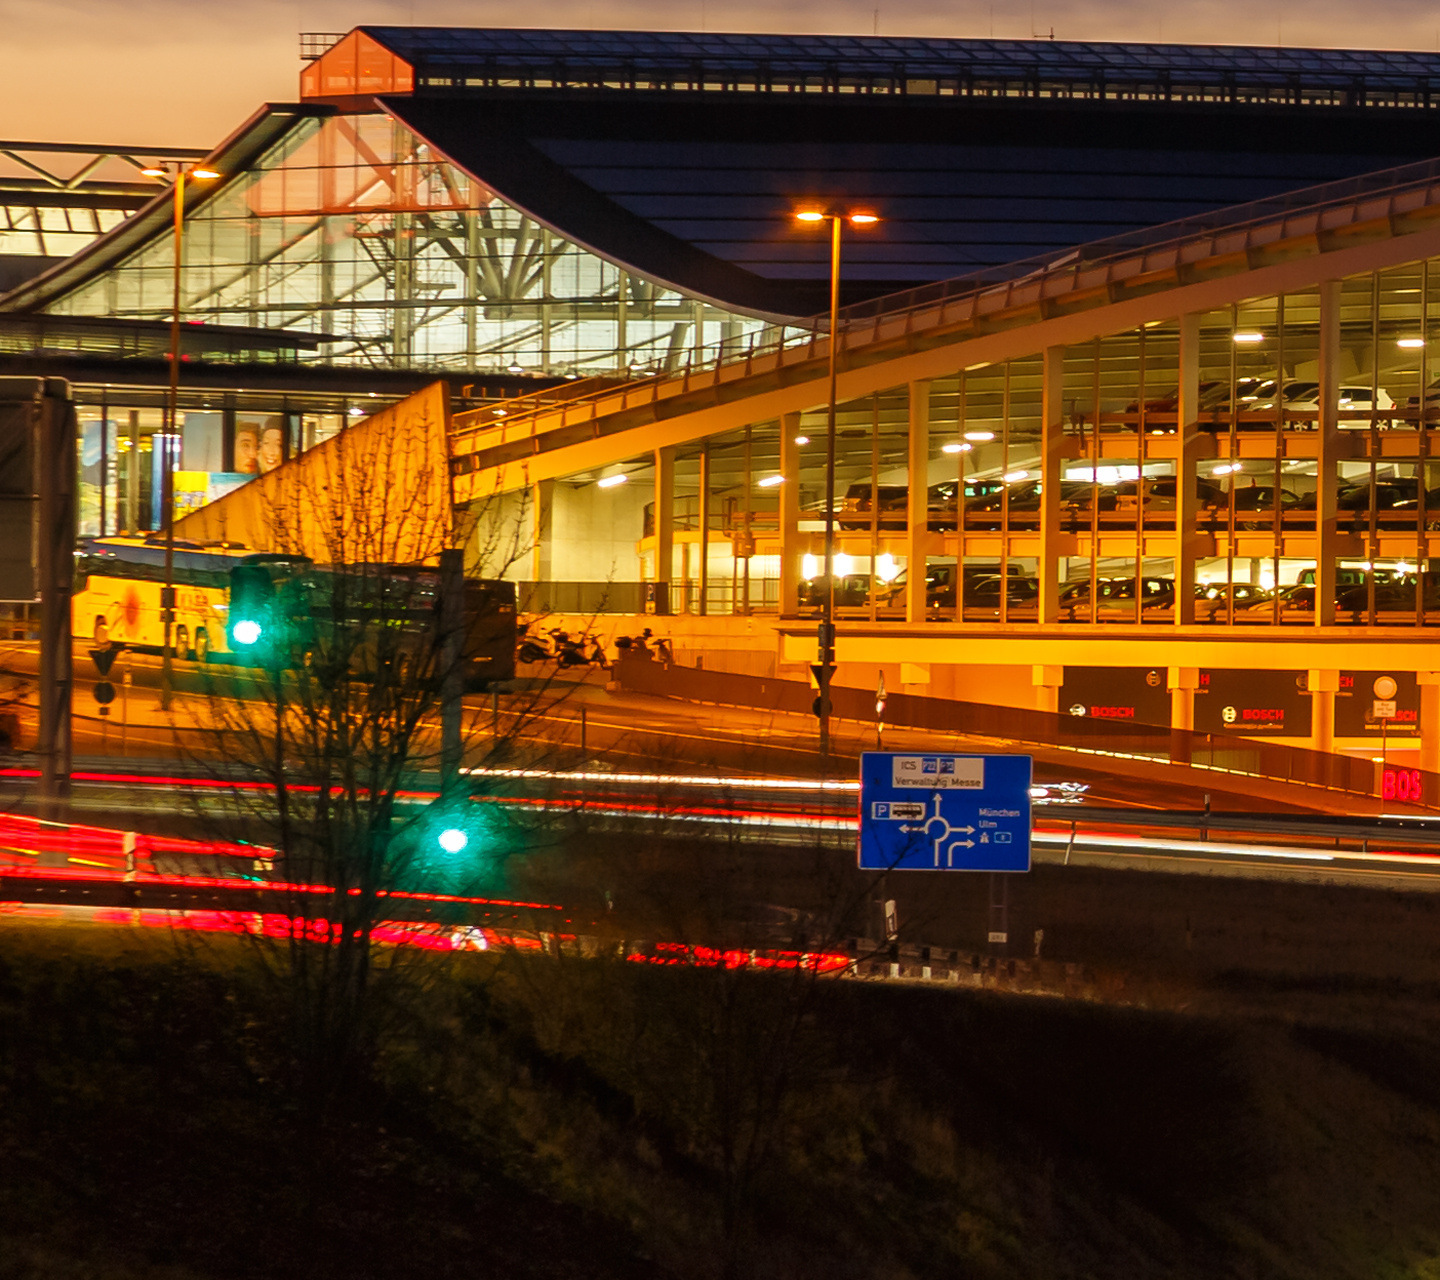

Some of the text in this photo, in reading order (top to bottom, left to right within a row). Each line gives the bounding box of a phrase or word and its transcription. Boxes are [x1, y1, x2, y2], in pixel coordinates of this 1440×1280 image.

[1091, 706, 1134, 717] BOSCH
[1243, 709, 1284, 720] BOSCH
[951, 778, 981, 787] Messe
[1383, 770, 1422, 801] BOS
[979, 807, 1020, 817] München
[979, 820, 997, 829] Ulm
